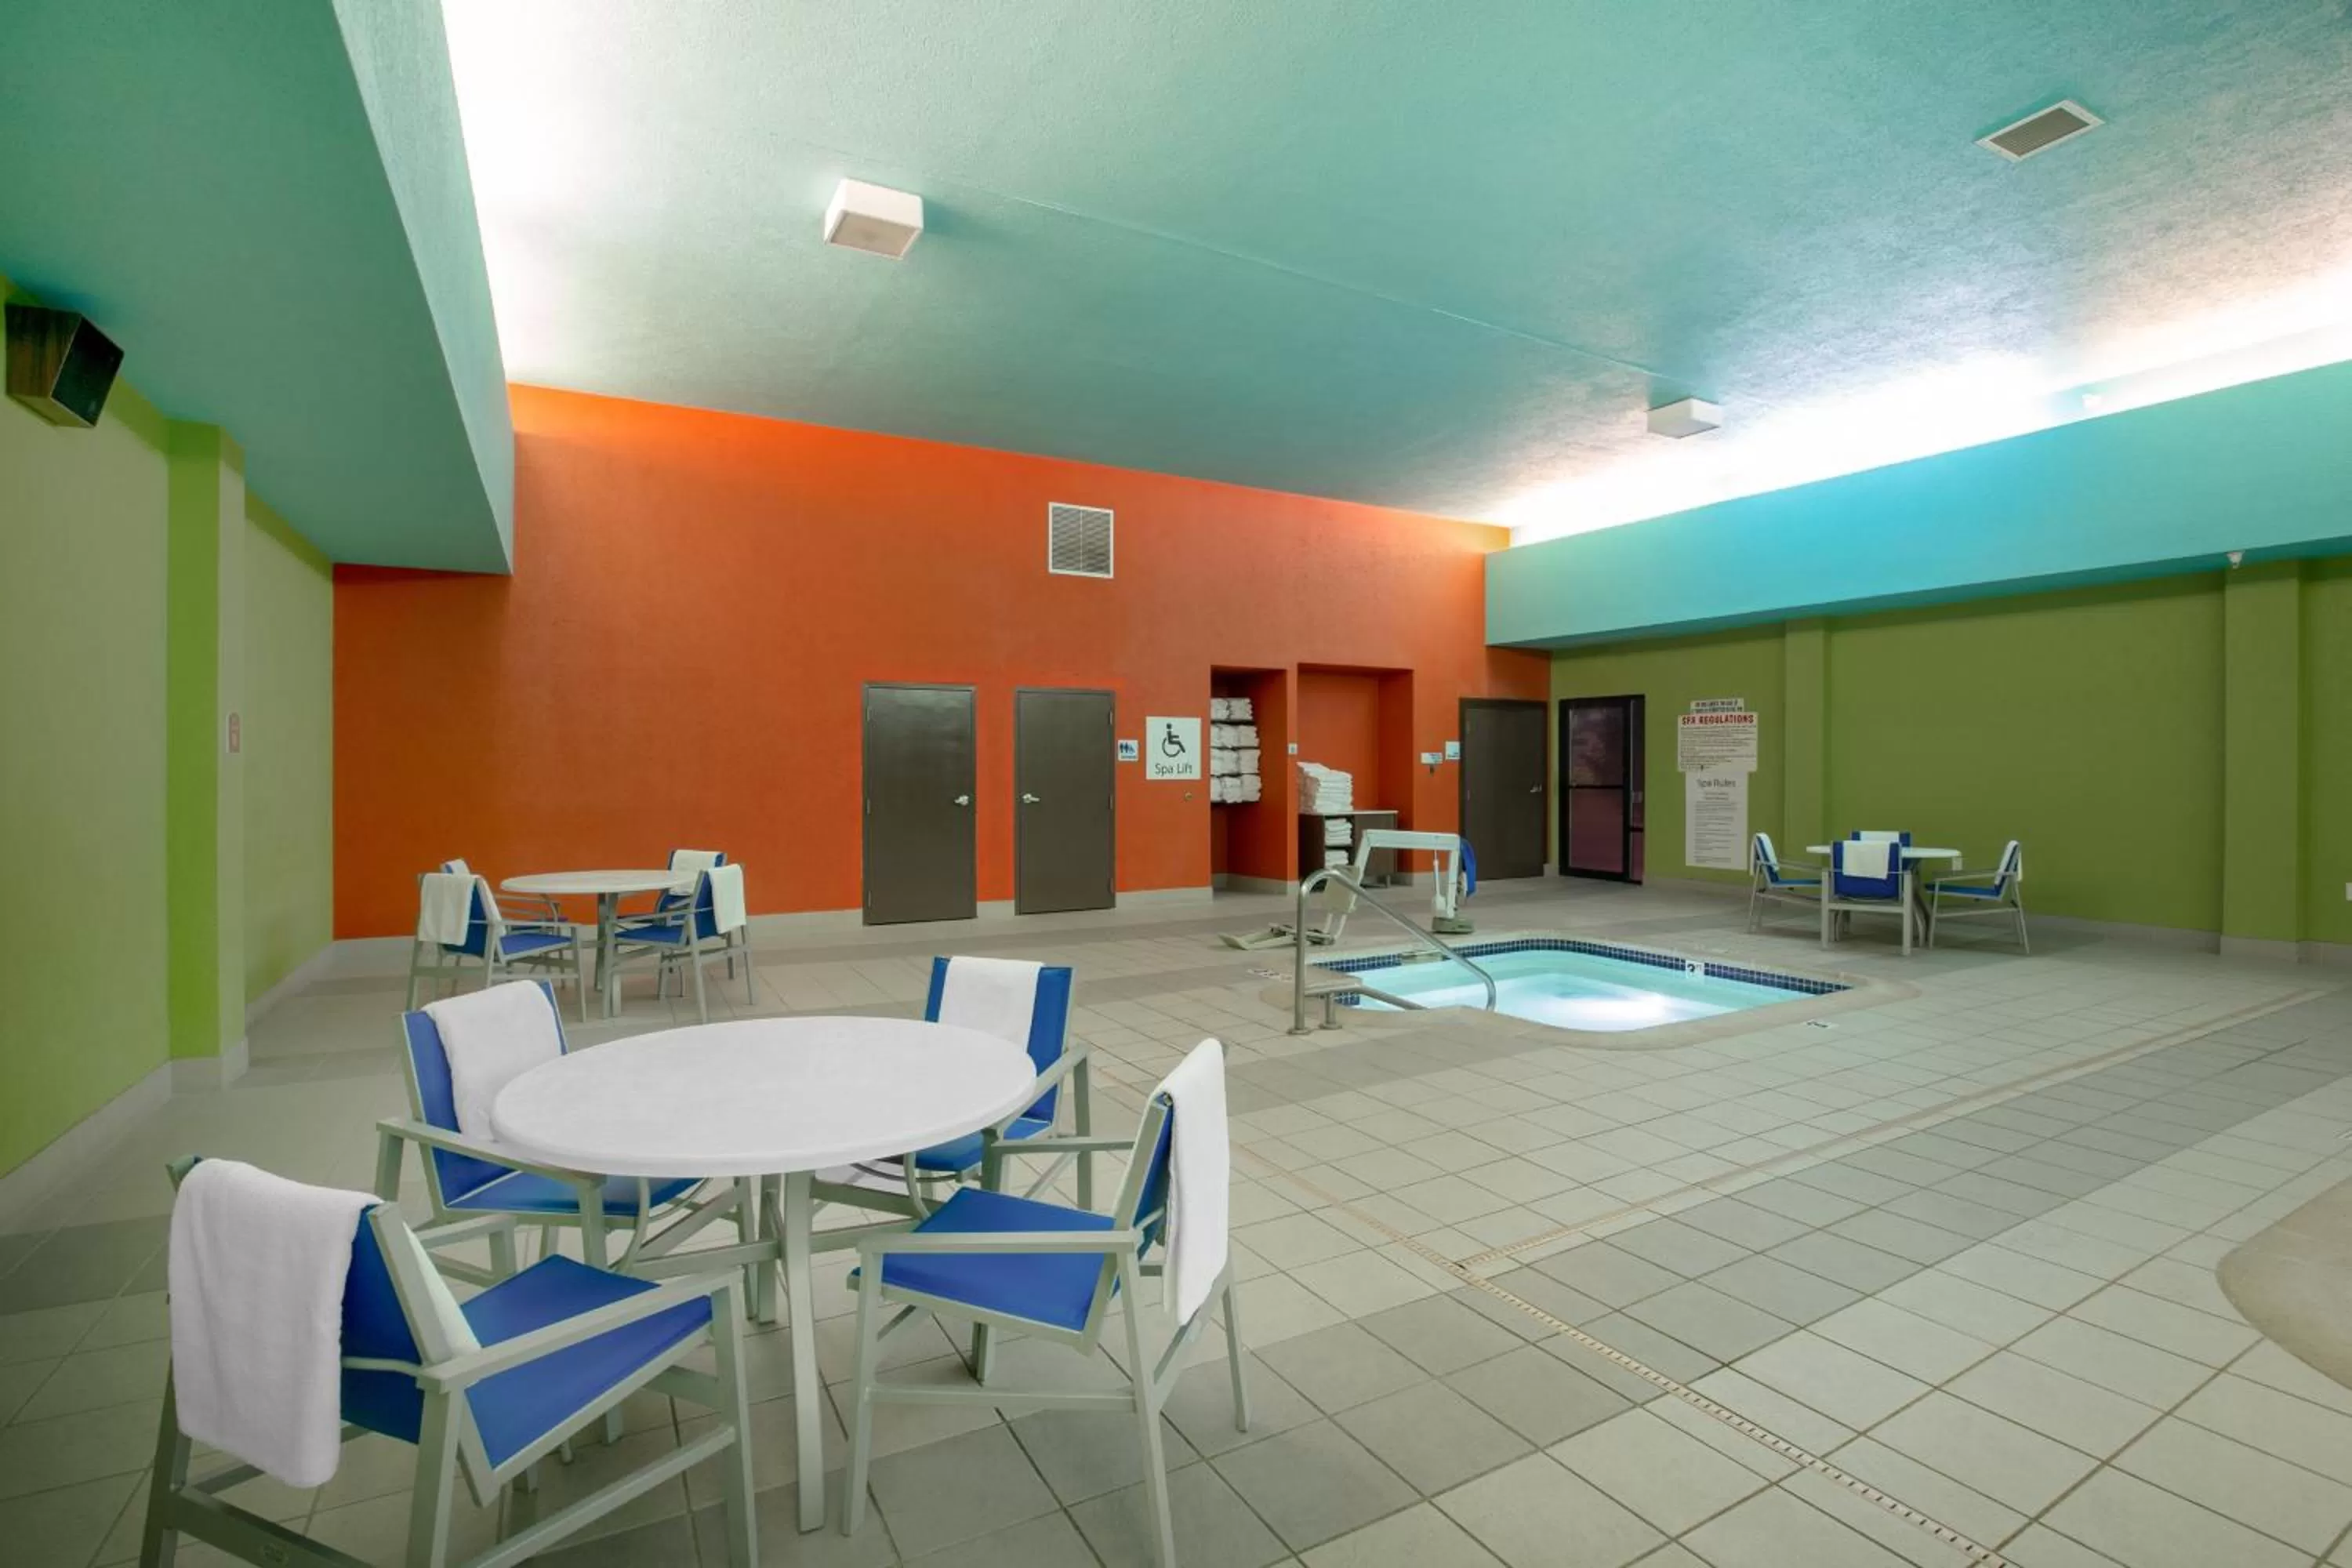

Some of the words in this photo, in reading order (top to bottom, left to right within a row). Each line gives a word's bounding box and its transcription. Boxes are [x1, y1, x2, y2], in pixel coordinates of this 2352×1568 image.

[1682, 716, 1696, 725] SPA
[1699, 714, 1754, 725] REGULATIONS
[1155, 763, 1173, 776] Spa
[1177, 761, 1192, 775] Lift
